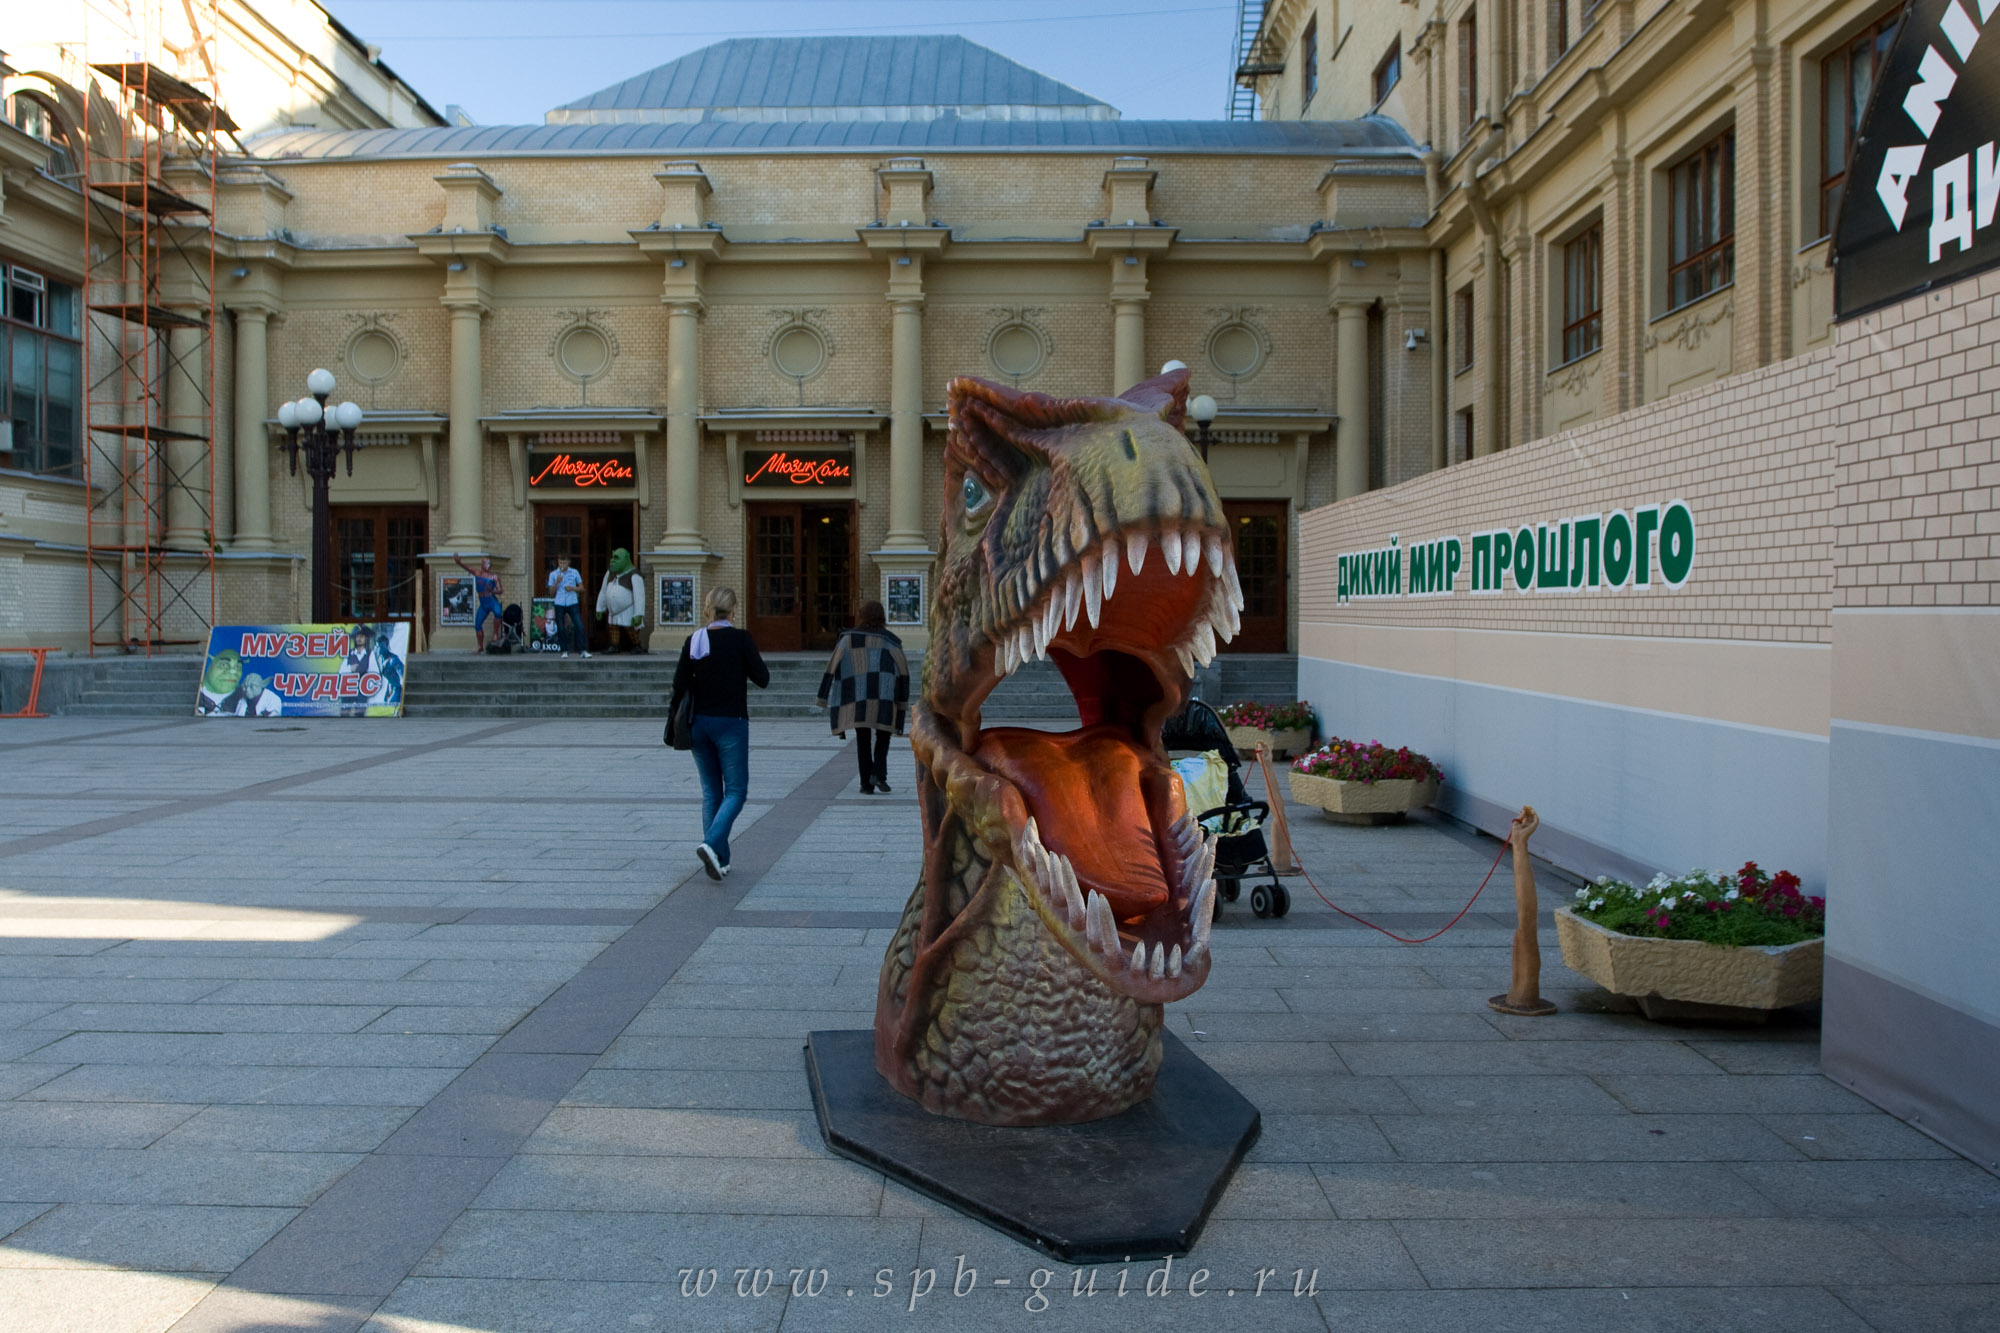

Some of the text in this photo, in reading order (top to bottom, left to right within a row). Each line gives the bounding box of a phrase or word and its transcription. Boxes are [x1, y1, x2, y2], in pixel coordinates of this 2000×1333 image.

[1337, 500, 1694, 605] ДИКИЙ МИР ПРОШЛОГО
[240, 628, 350, 658] МУЗЕЙ
[273, 673, 382, 701] ЧУДЕС
